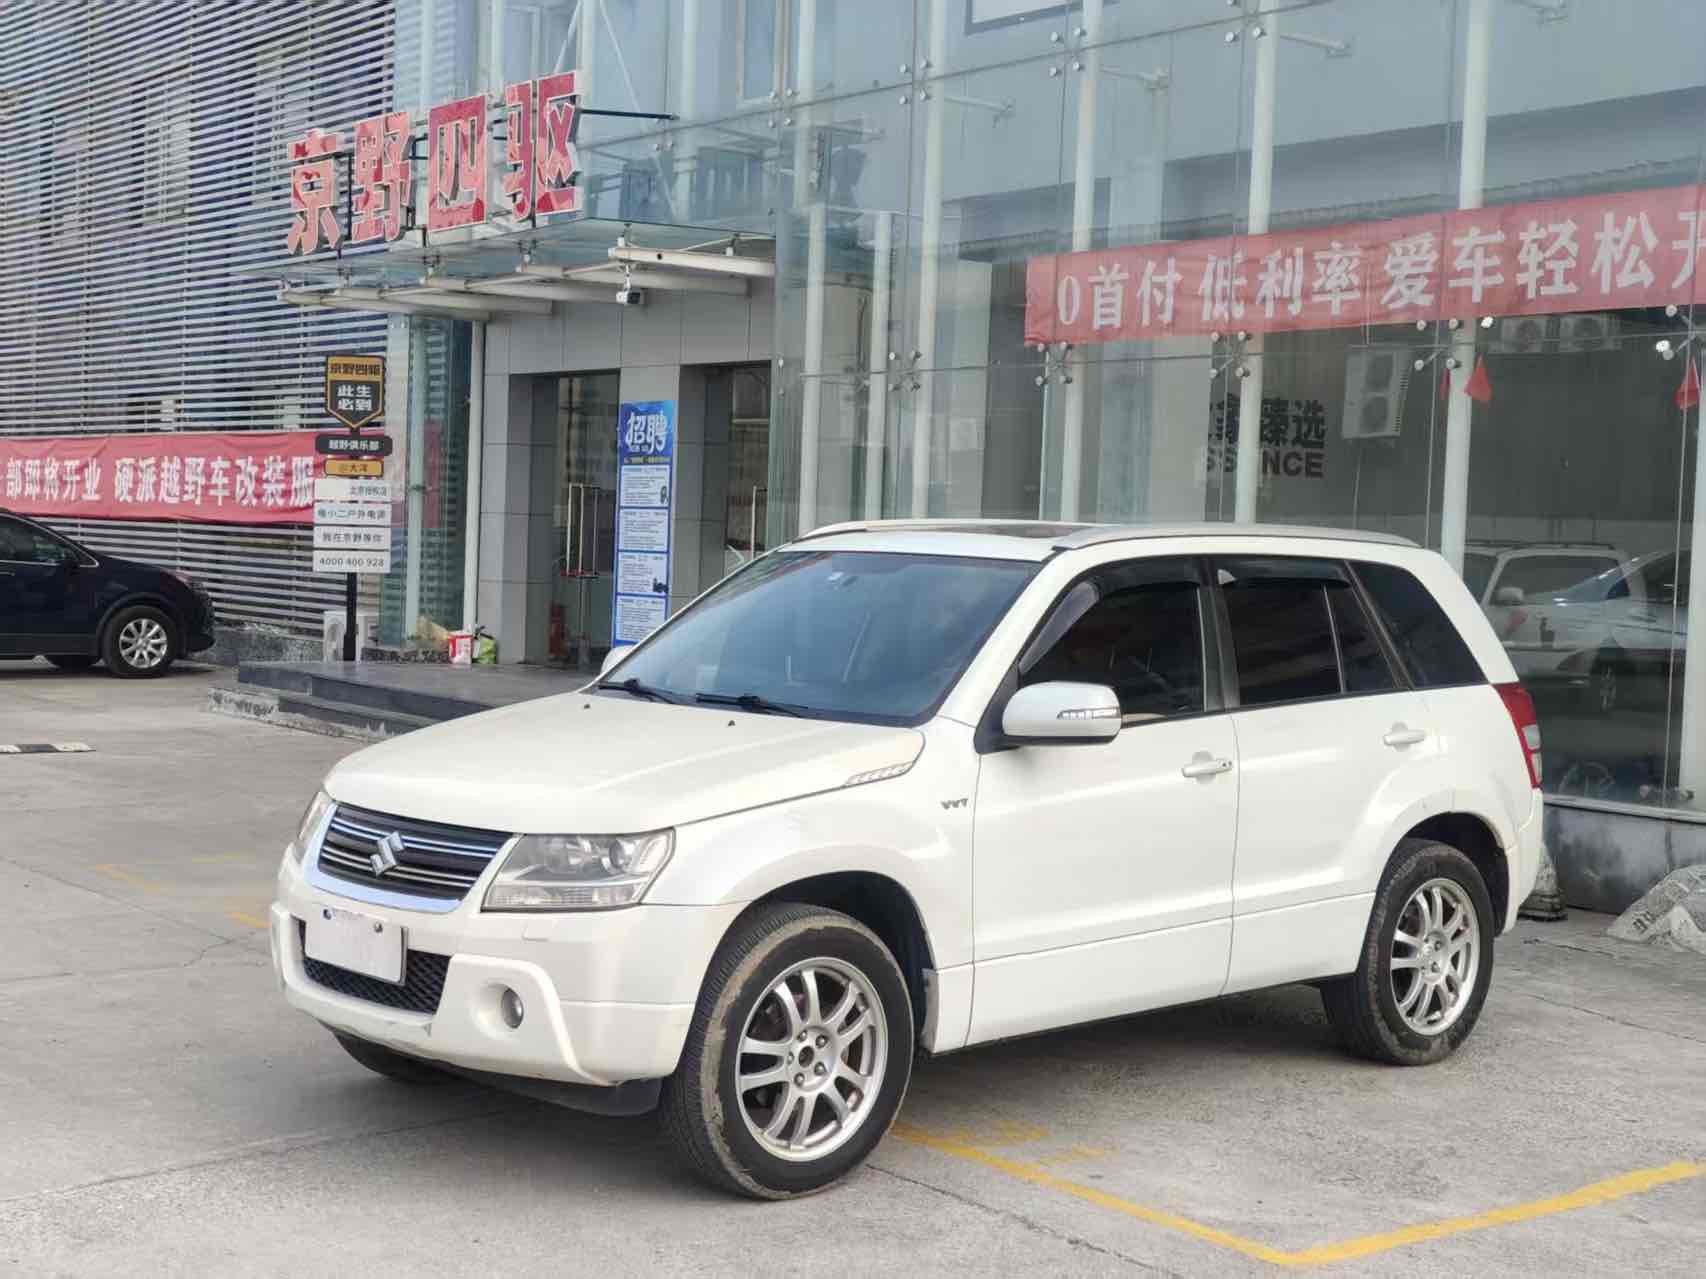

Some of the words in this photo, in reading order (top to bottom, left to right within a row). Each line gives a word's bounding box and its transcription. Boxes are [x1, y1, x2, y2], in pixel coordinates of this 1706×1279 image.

[288, 72, 577, 255] 京野四驱
[625, 410, 669, 455] 招聘
